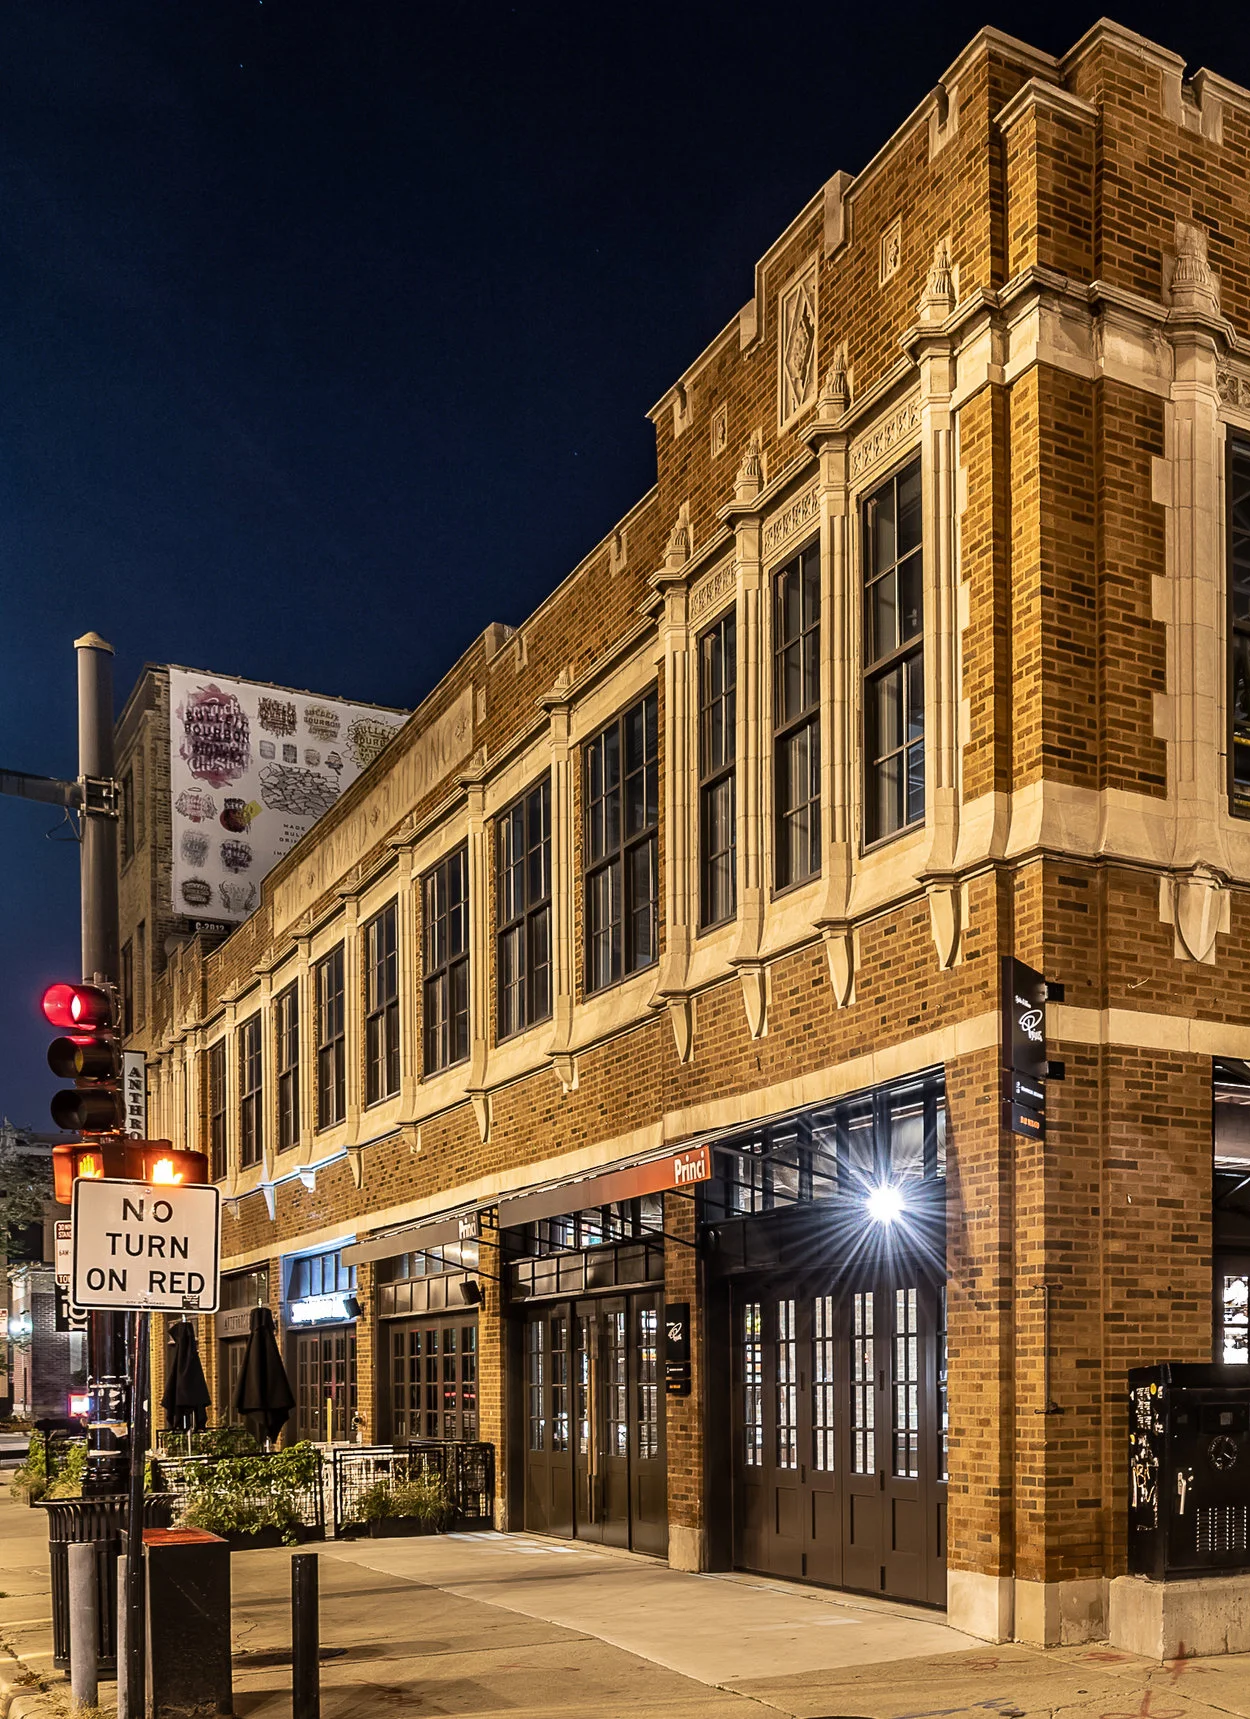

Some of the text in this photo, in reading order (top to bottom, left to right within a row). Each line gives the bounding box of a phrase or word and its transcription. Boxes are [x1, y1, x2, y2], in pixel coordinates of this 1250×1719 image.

[184, 723, 249, 743] BOURBON
[316, 809, 368, 891] HOWARD
[382, 722, 455, 828] BUILDING
[673, 1150, 706, 1185] Princi
[122, 1197, 174, 1223] NO
[105, 1232, 189, 1260] TURN
[86, 1267, 205, 1295] ON RED
